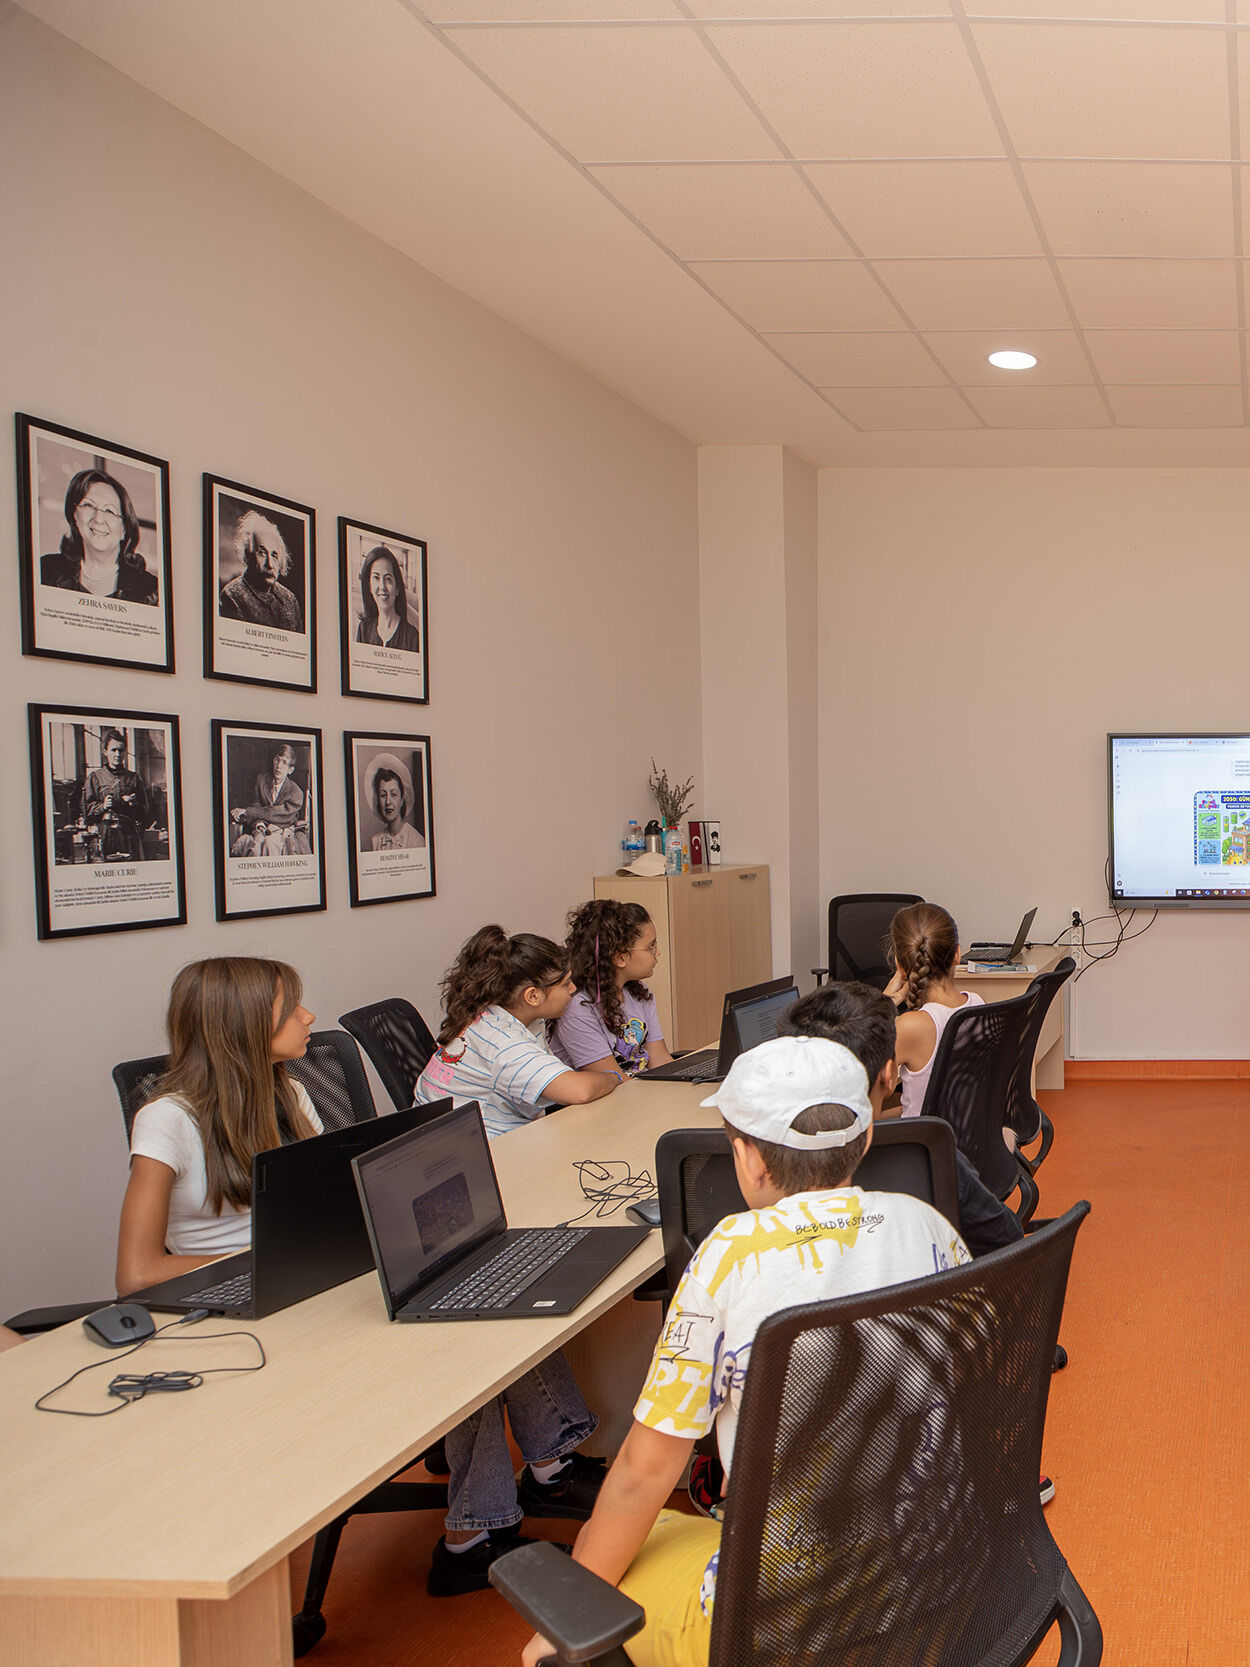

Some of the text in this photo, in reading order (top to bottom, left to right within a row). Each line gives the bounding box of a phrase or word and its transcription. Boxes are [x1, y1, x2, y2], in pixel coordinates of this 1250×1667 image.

[78, 597, 128, 613] ZEHRA SAYERS
[245, 628, 289, 642] ALBERT EINSTEIN
[237, 862, 262, 870] STEPHEN
[94, 868, 138, 878] MARIE CURIE
